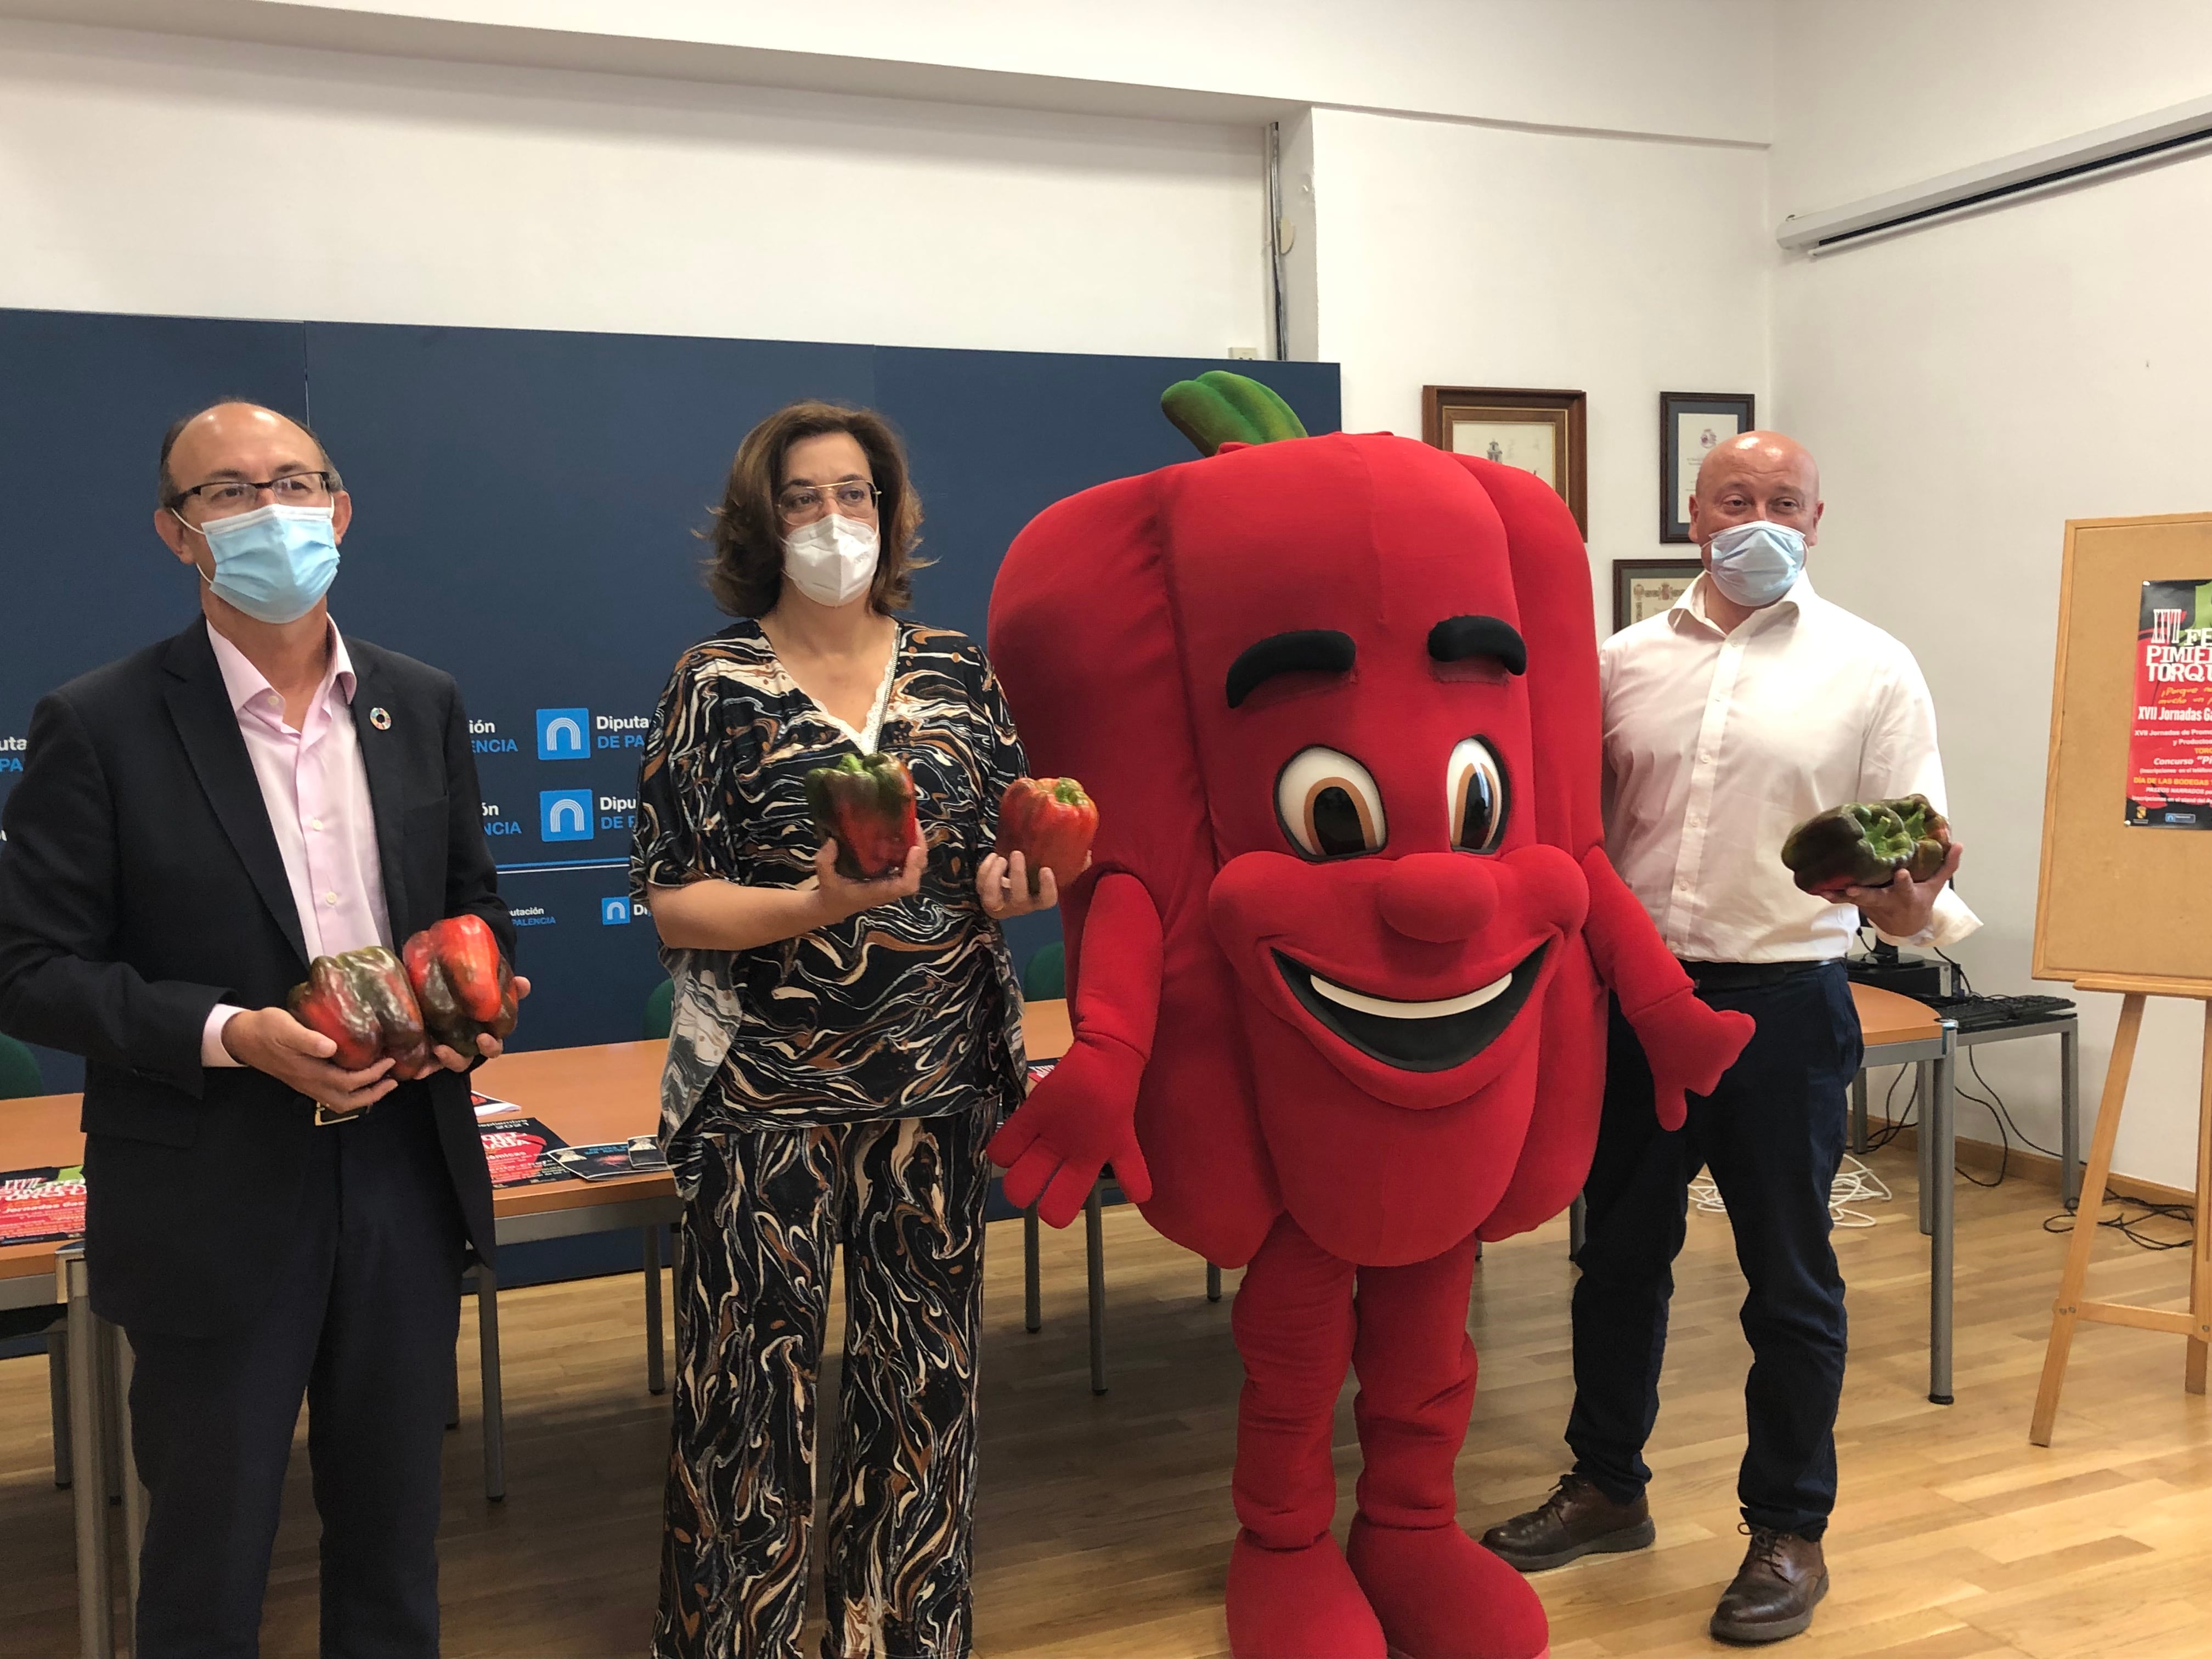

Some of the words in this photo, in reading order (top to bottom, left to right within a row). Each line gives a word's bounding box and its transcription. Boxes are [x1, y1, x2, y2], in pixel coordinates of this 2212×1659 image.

[2137, 706, 2157, 720] XVII
[2158, 707, 2202, 721] Jornadas
[2204, 707, 2212, 721] G
[469, 719, 496, 733] ión
[596, 715, 652, 732] Diputa
[597, 736, 620, 748] DE
[624, 735, 645, 748] PA
[600, 797, 636, 812] Dipu
[601, 816, 623, 829] DE
